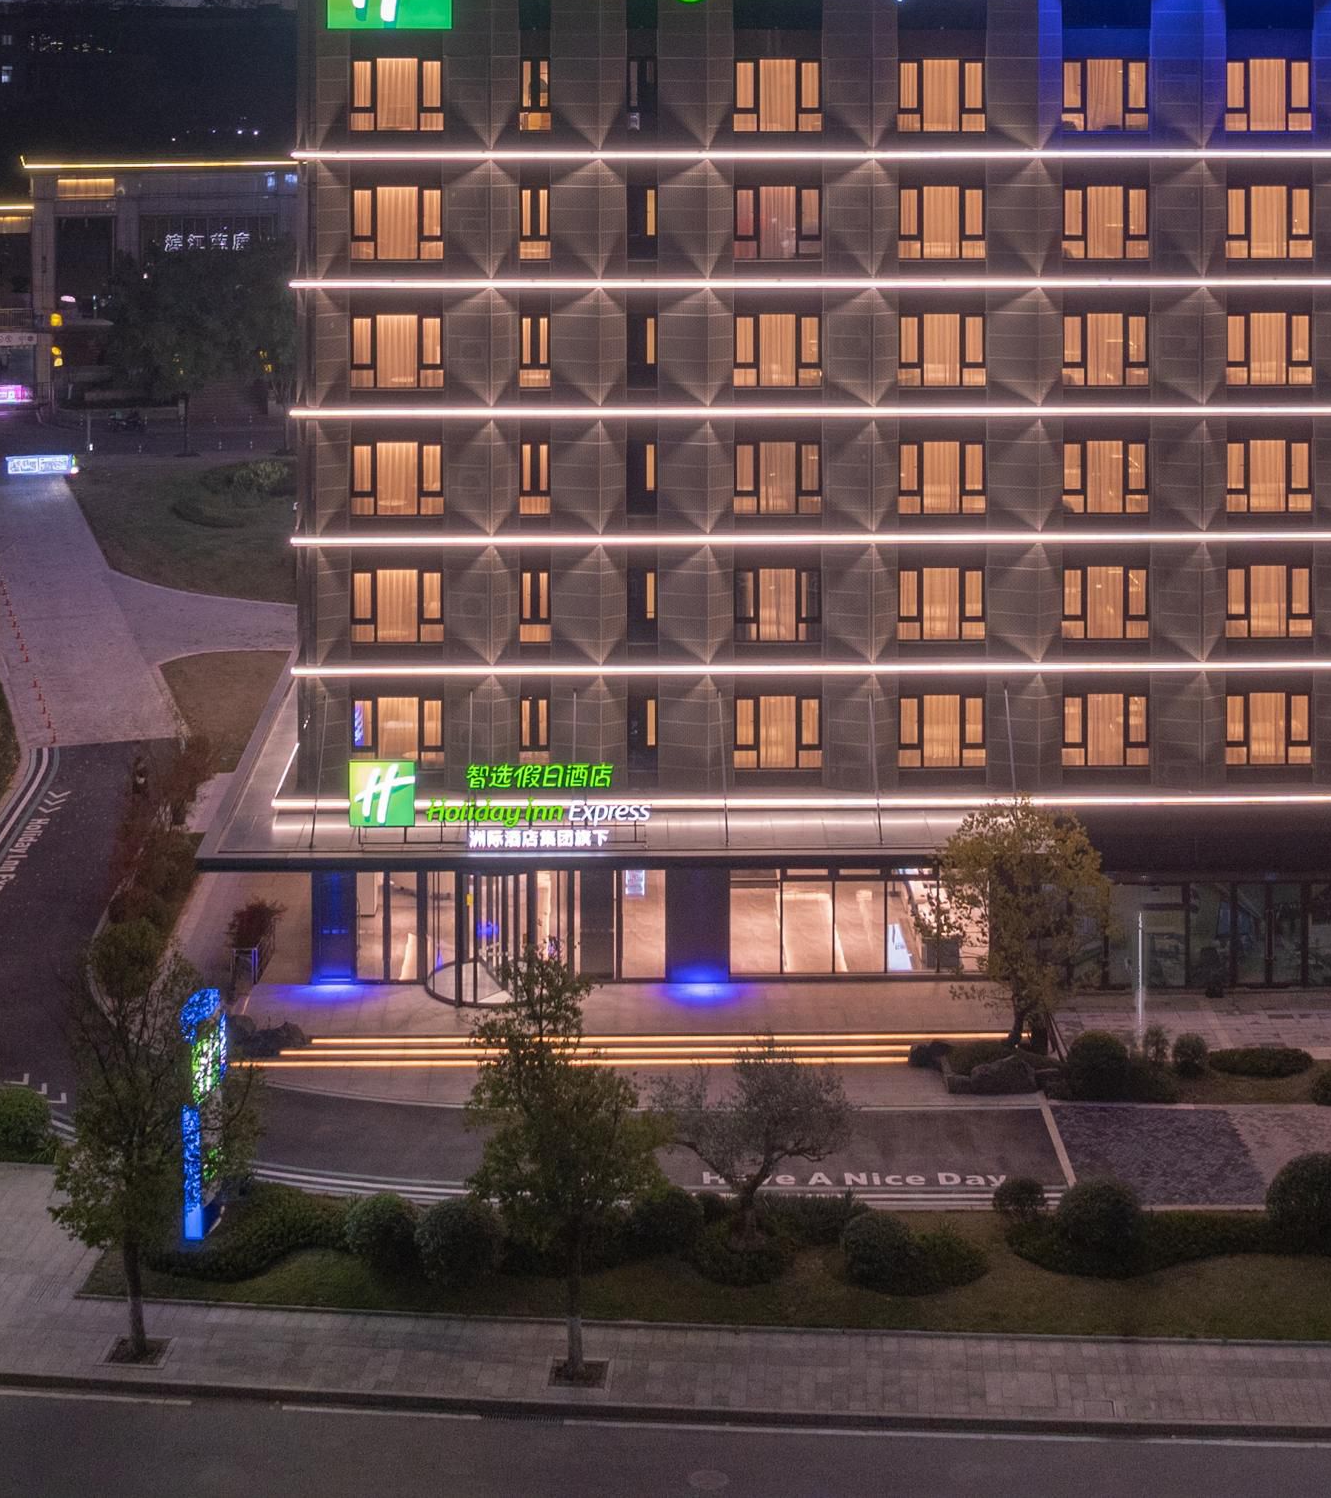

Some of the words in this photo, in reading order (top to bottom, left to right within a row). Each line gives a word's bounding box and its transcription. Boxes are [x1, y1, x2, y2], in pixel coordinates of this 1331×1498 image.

[466, 763, 614, 790] 智选假日酒店
[426, 798, 520, 828] Holiday
[568, 801, 653, 826] Express
[8, 817, 51, 854] Holiday
[468, 829, 610, 848] 洲际酒店集团旗下
[807, 1171, 833, 1186] A
[844, 1171, 926, 1186] Nice
[937, 1171, 1006, 1188] Day
